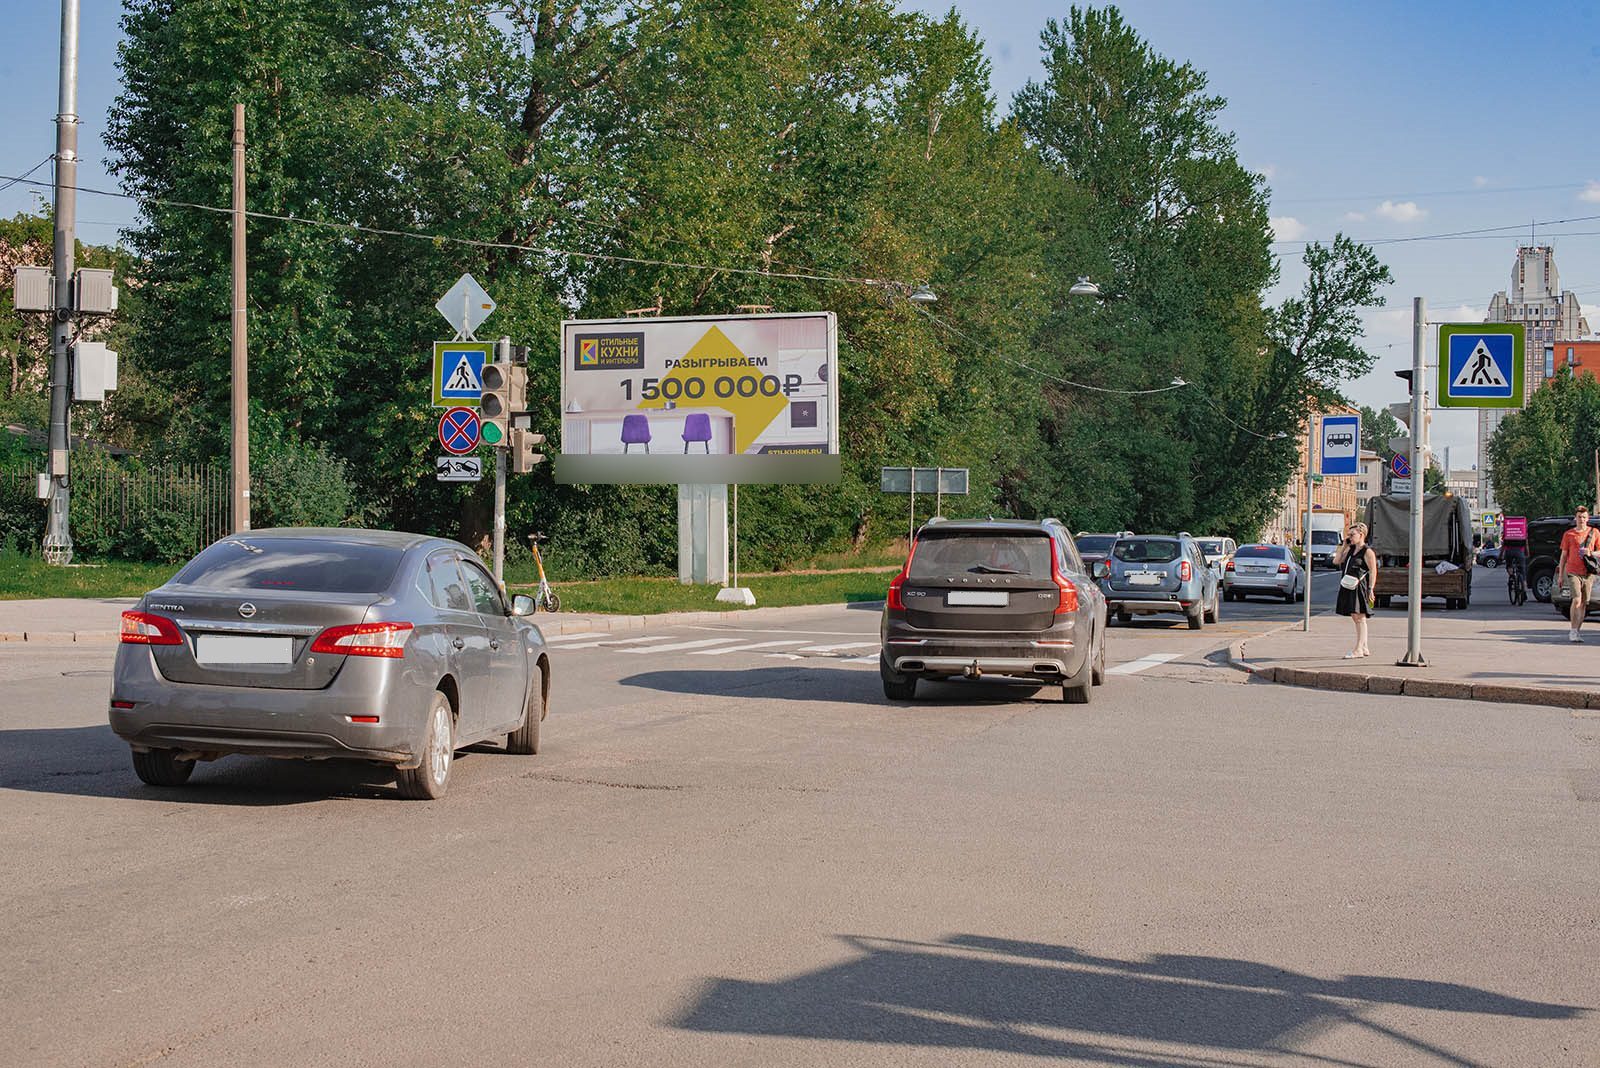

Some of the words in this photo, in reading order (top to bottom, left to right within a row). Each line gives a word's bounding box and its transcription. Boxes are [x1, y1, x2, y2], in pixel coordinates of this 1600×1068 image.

[600, 338, 639, 346] СТИЛЬНЫЕ
[600, 346, 639, 358] КУХНИ
[665, 357, 768, 369] РАЗЫГРЫВАЕМ
[620, 379, 632, 401] 1
[641, 377, 706, 401] 500
